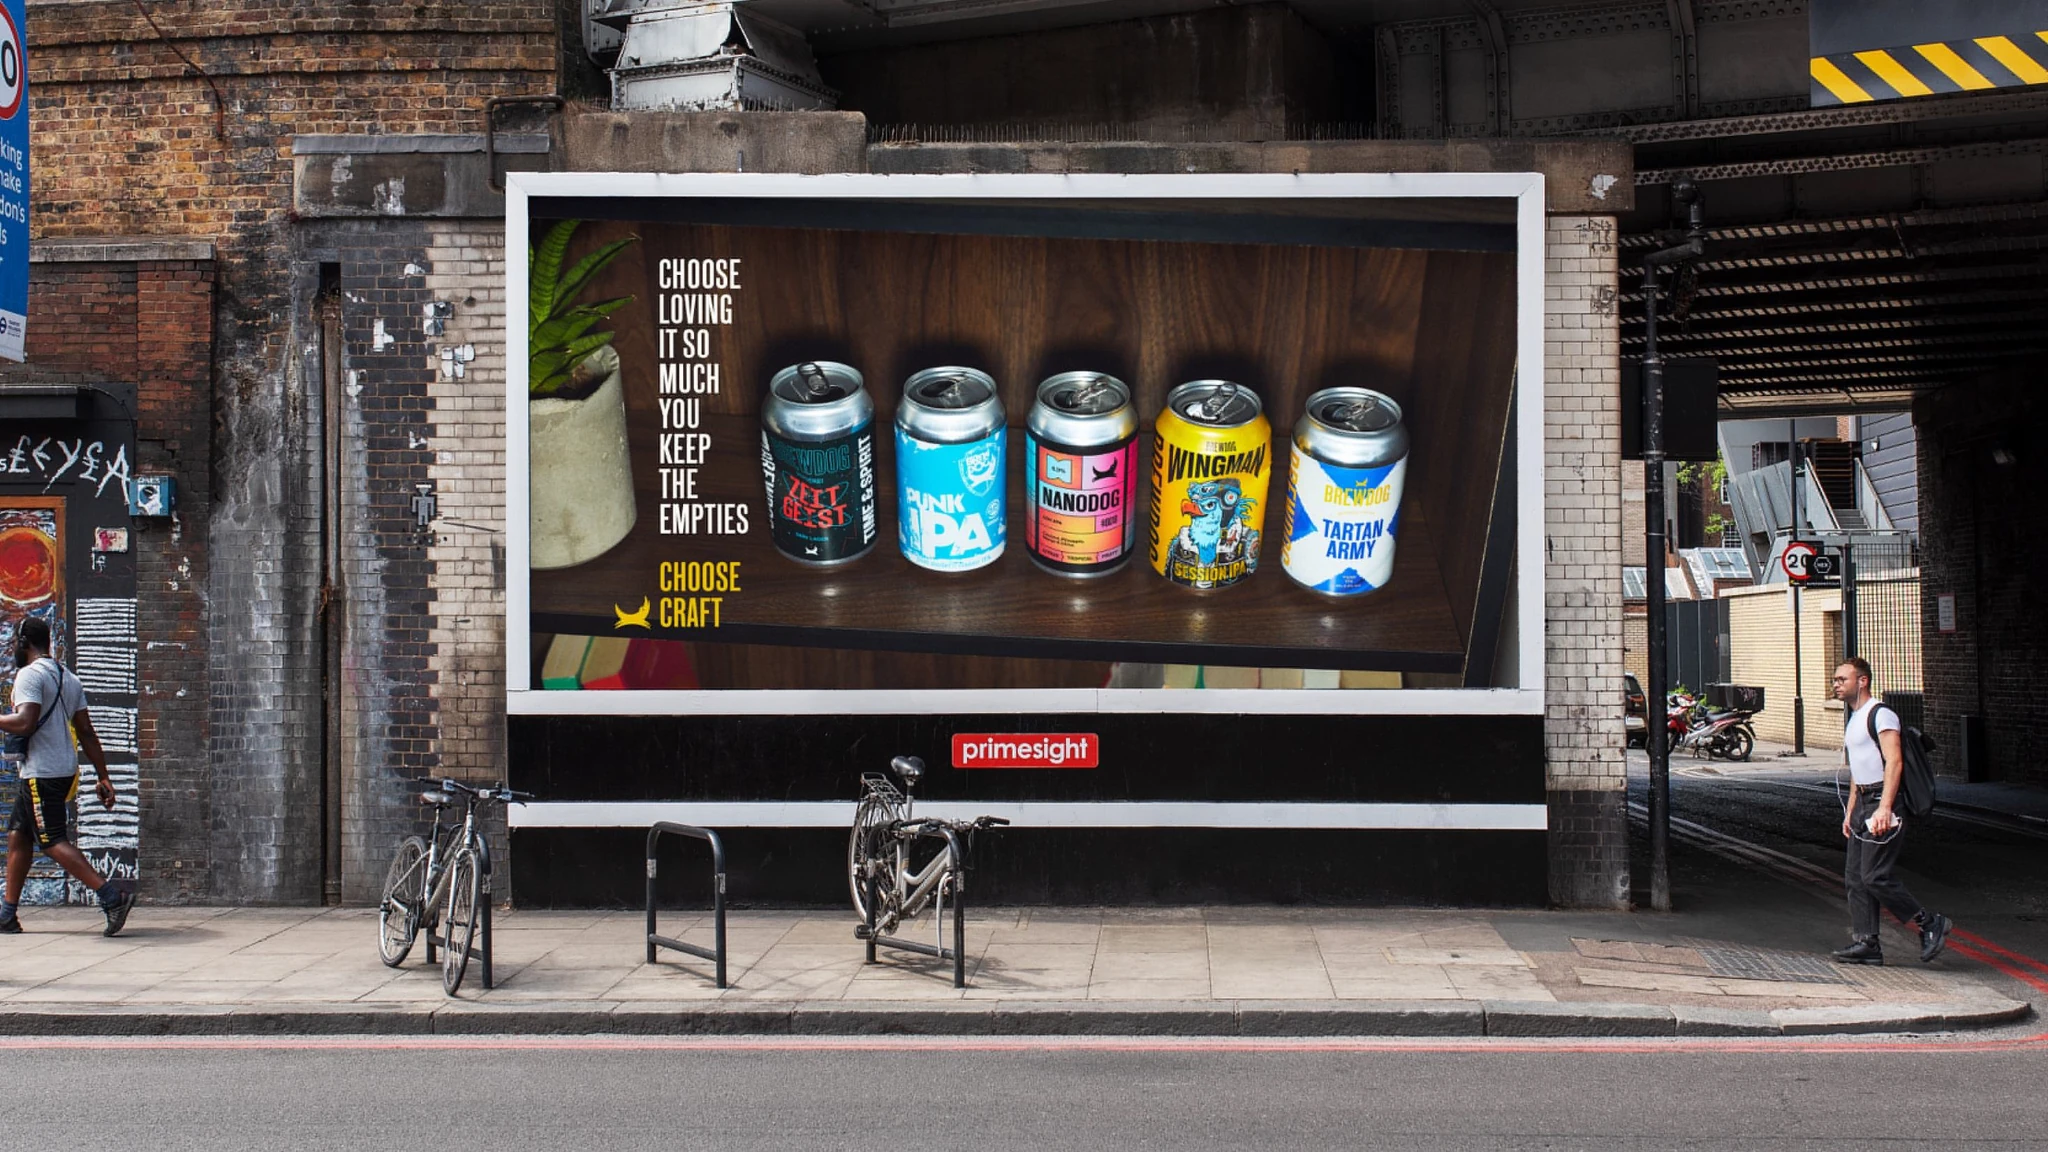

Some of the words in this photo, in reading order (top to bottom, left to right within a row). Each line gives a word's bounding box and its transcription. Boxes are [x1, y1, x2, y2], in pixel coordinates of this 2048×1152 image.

[659, 258, 742, 290] CHOOSE
[659, 293, 733, 325] LOVING
[659, 328, 678, 359] IT
[682, 328, 710, 359] SO
[659, 363, 720, 394] MUCH
[658, 398, 700, 429] YOU
[659, 433, 712, 464] KEEP
[858, 435, 873, 489] SPIRIT
[1167, 442, 1266, 483] WINGMAN
[658, 468, 699, 499] THE
[789, 475, 840, 509] ZEIT
[860, 484, 874, 502] &
[1323, 484, 1391, 507] BREWDOG
[783, 496, 848, 529] GEIST
[906, 486, 966, 514] PUNK
[1043, 486, 1120, 513] NANODOG
[659, 503, 749, 535] EMPTIES
[862, 499, 876, 544] TIME
[909, 506, 993, 559] IPA
[1322, 518, 1384, 541] TARTAN
[1326, 540, 1377, 560] ARMY
[659, 561, 741, 592] CHOOSE
[1174, 562, 1227, 581] SESSION
[1229, 560, 1247, 578] IPA
[659, 597, 723, 628] CRAFT
[963, 738, 1088, 764] primesight
